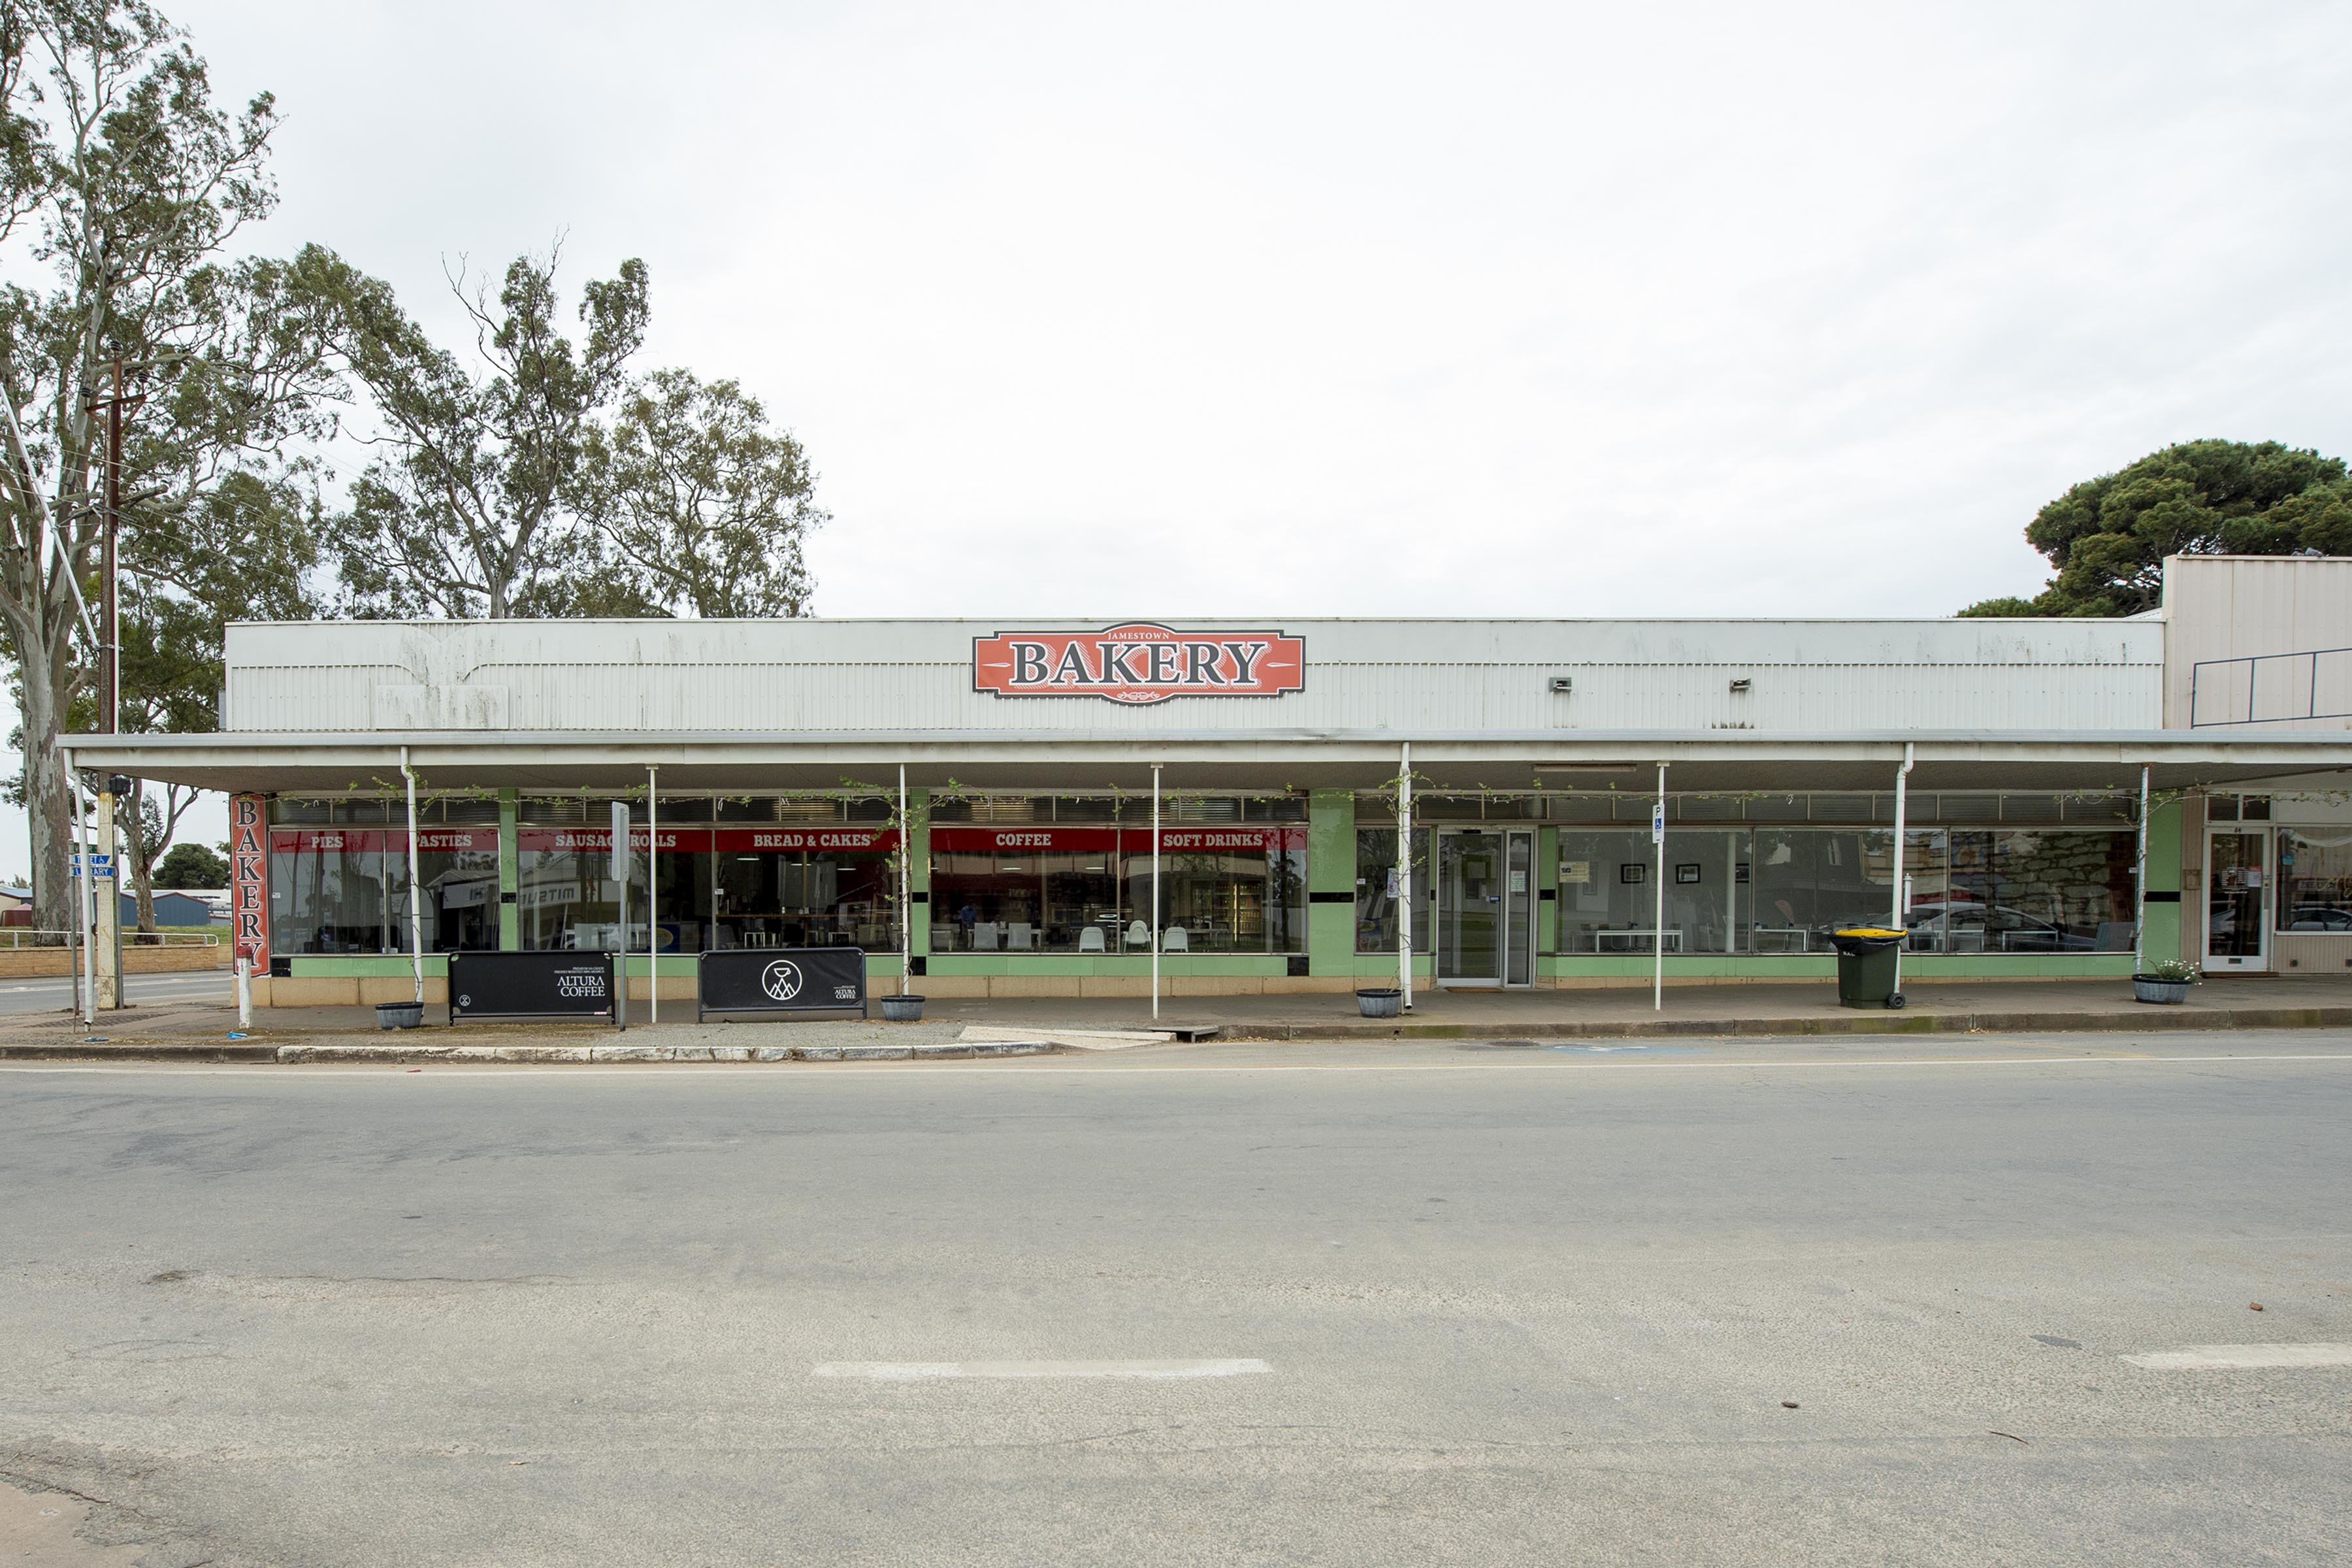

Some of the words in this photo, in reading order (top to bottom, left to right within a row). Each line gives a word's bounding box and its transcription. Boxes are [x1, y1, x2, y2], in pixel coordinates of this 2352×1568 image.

[1107, 632, 1169, 640] JAMESTOWN
[1010, 640, 1268, 687] BAKERY
[312, 836, 344, 848] PIES
[630, 834, 677, 847] ROLS
[753, 834, 804, 847] BREAD
[807, 835, 817, 847] &
[820, 834, 871, 847] CAKES
[996, 833, 1051, 846] COFFEE
[1163, 834, 1202, 847] SOFT
[1205, 833, 1263, 847] DRINKS
[557, 975, 605, 986] ALTURA
[561, 987, 606, 997] COFFEE
